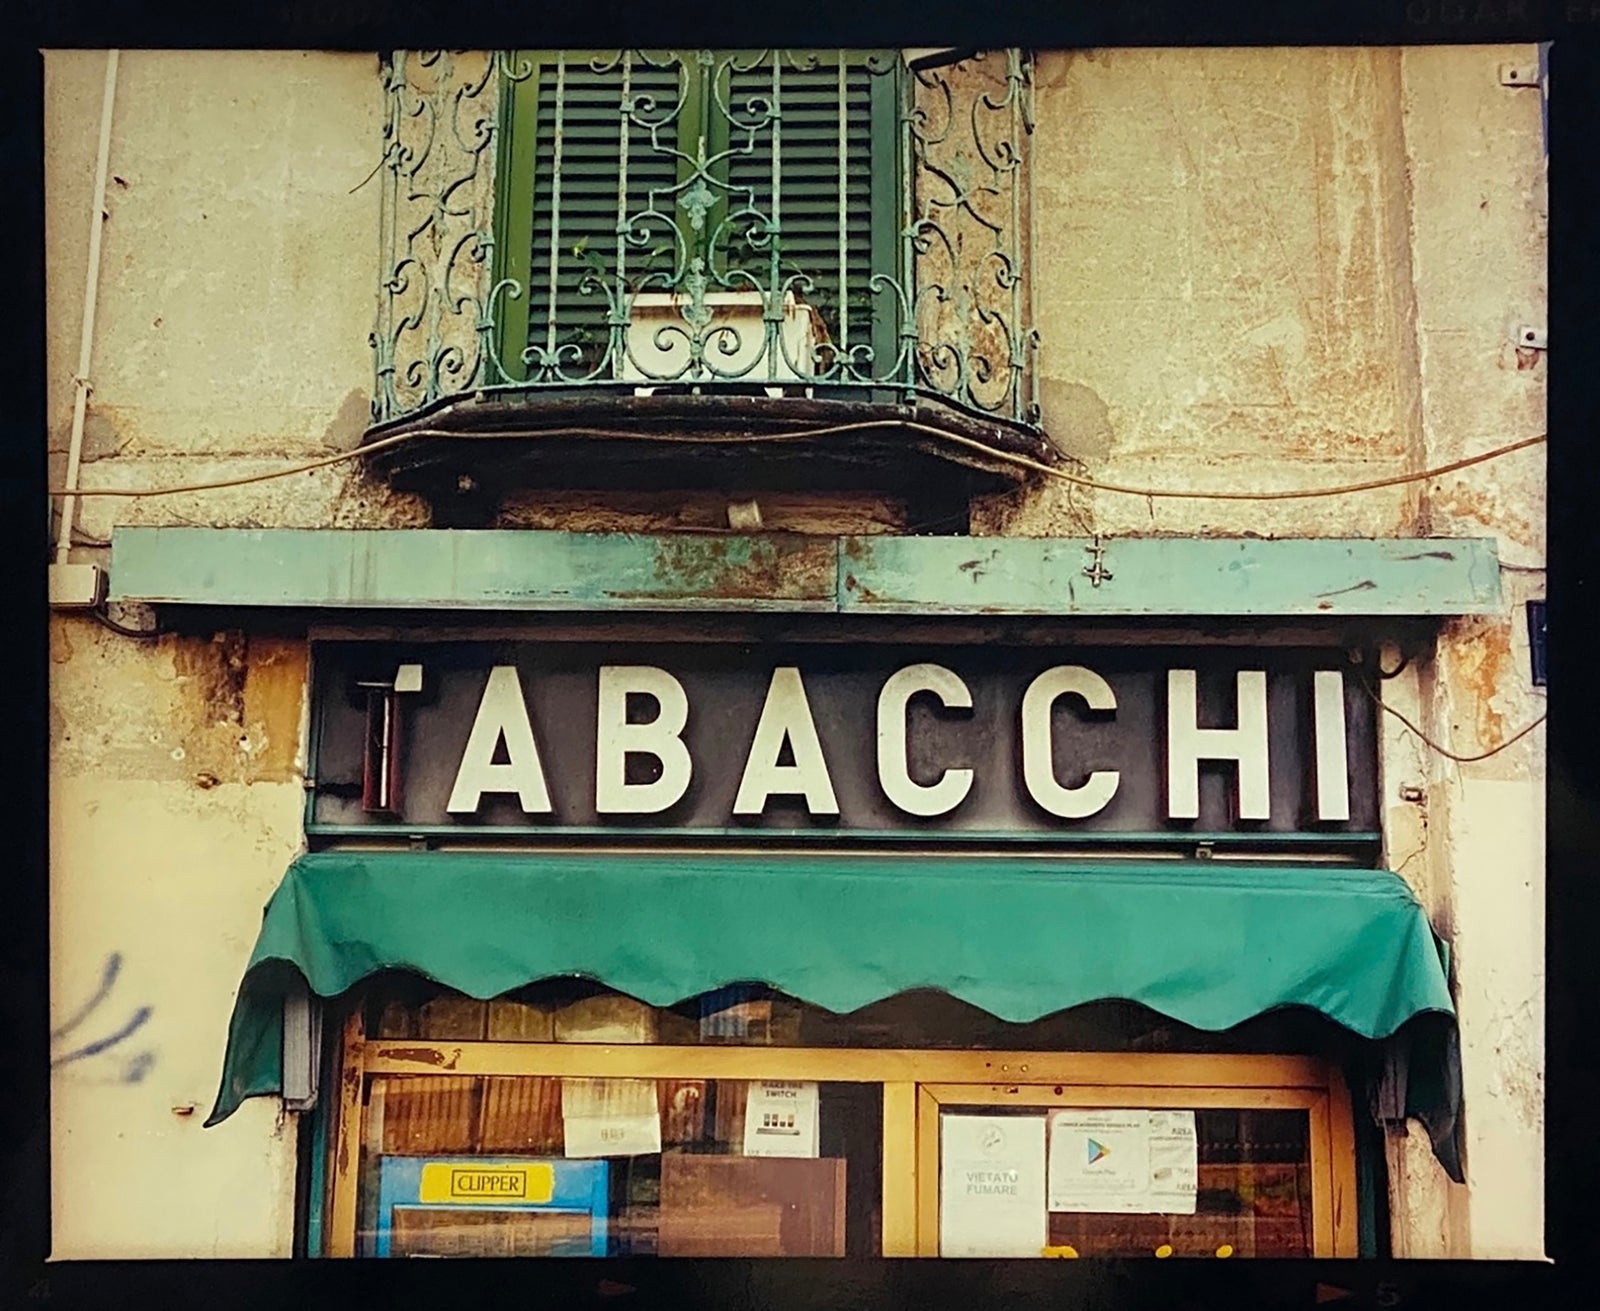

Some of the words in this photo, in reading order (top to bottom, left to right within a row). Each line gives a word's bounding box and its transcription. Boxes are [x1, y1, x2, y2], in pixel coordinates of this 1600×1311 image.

[766, 1090, 797, 1098] SWITCH
[966, 1172, 1018, 1183] VIETATO
[458, 1175, 519, 1192] CLIPPER
[966, 1184, 1017, 1195] FUMARE
